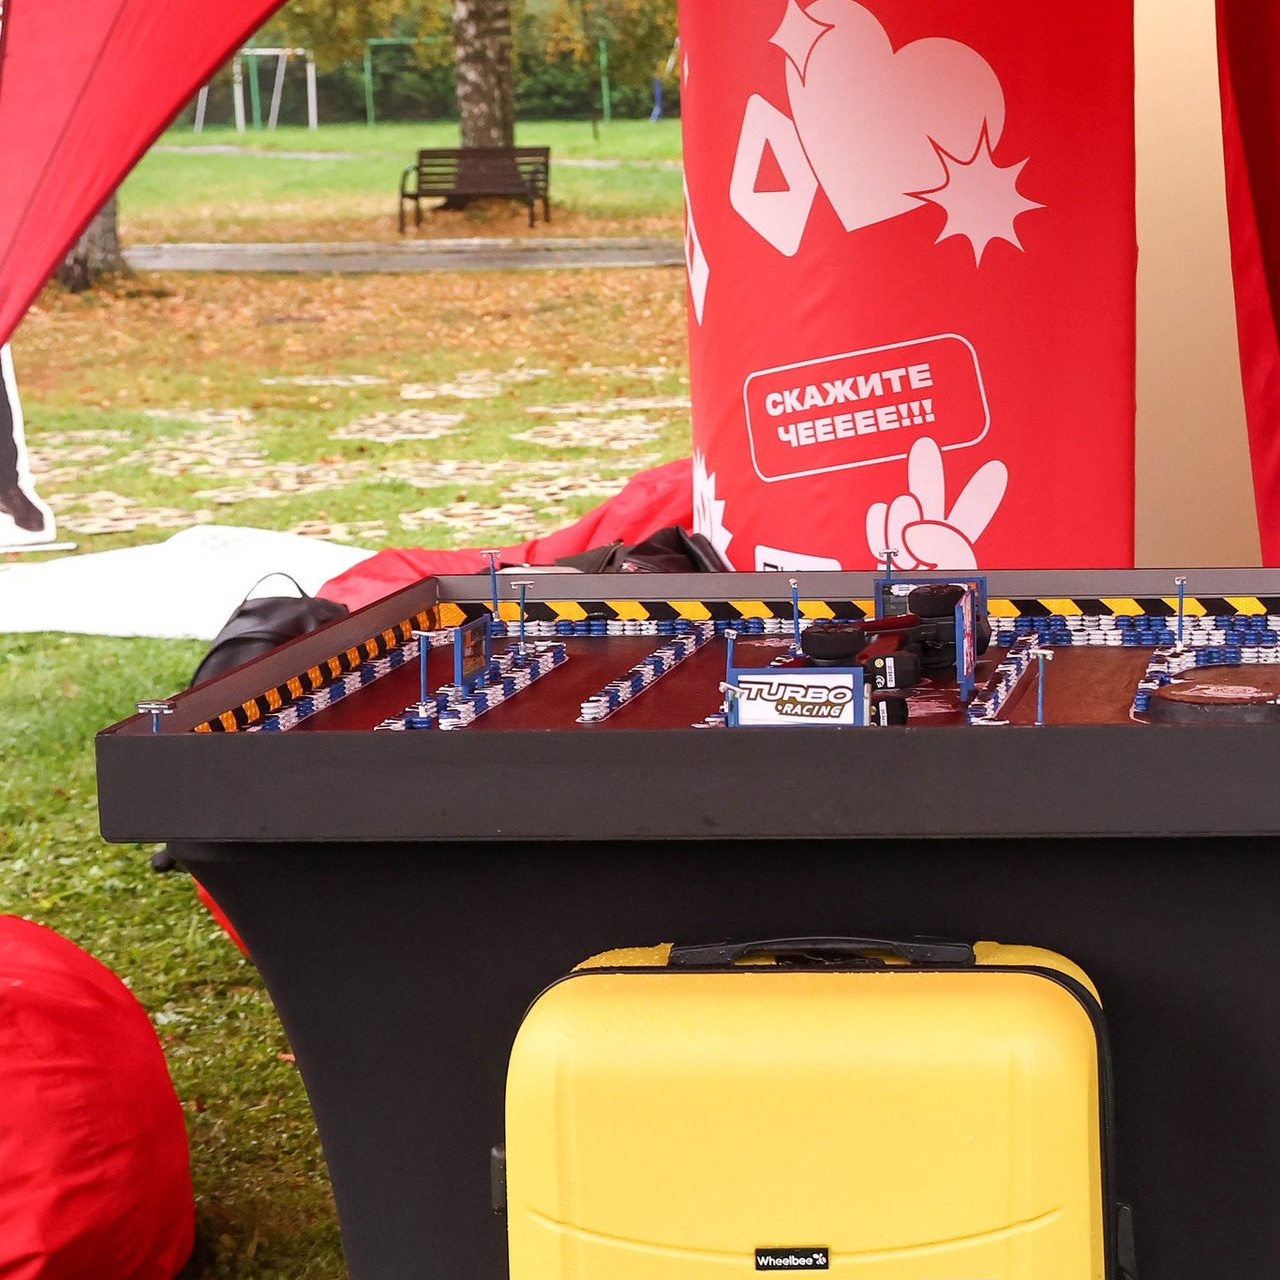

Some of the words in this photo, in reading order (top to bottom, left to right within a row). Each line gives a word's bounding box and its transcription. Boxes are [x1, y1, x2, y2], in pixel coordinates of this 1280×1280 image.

[765, 363, 934, 417] СКАЖИТЕ
[777, 398, 936, 448] ЧЕЕЕЕЕ!!!
[739, 681, 853, 704] TURBO
[782, 703, 843, 717] RACING
[757, 1255, 813, 1267] Wheelbee
